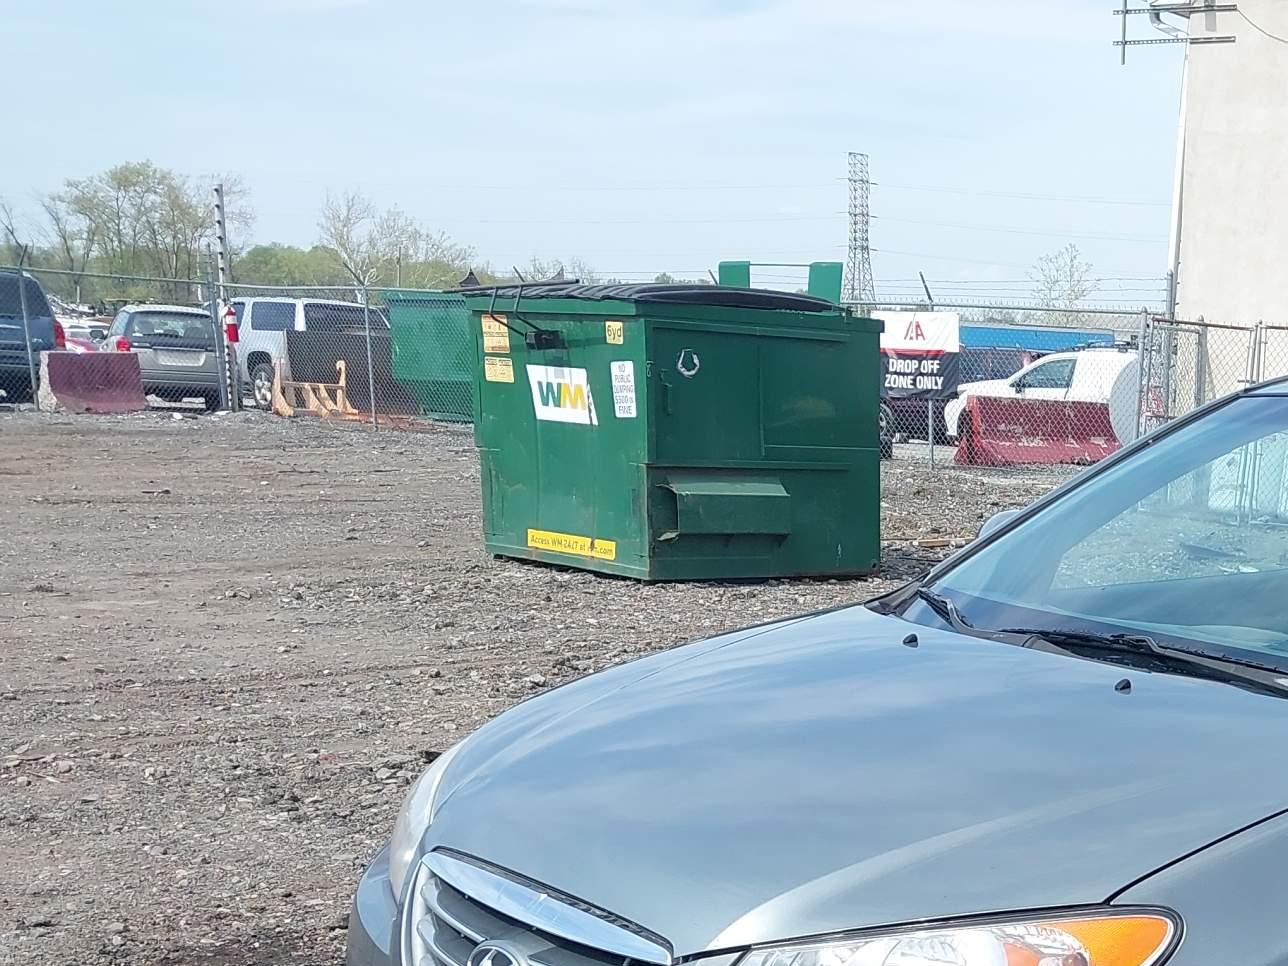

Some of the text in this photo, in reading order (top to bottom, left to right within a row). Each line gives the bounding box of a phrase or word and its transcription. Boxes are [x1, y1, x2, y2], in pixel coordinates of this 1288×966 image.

[607, 324, 622, 341] 6yd
[889, 359, 940, 374] DROP OFF
[884, 374, 944, 390] ZONE ONLY
[537, 381, 587, 410] WM
[531, 534, 550, 545] Access
[587, 545, 613, 556] .com
